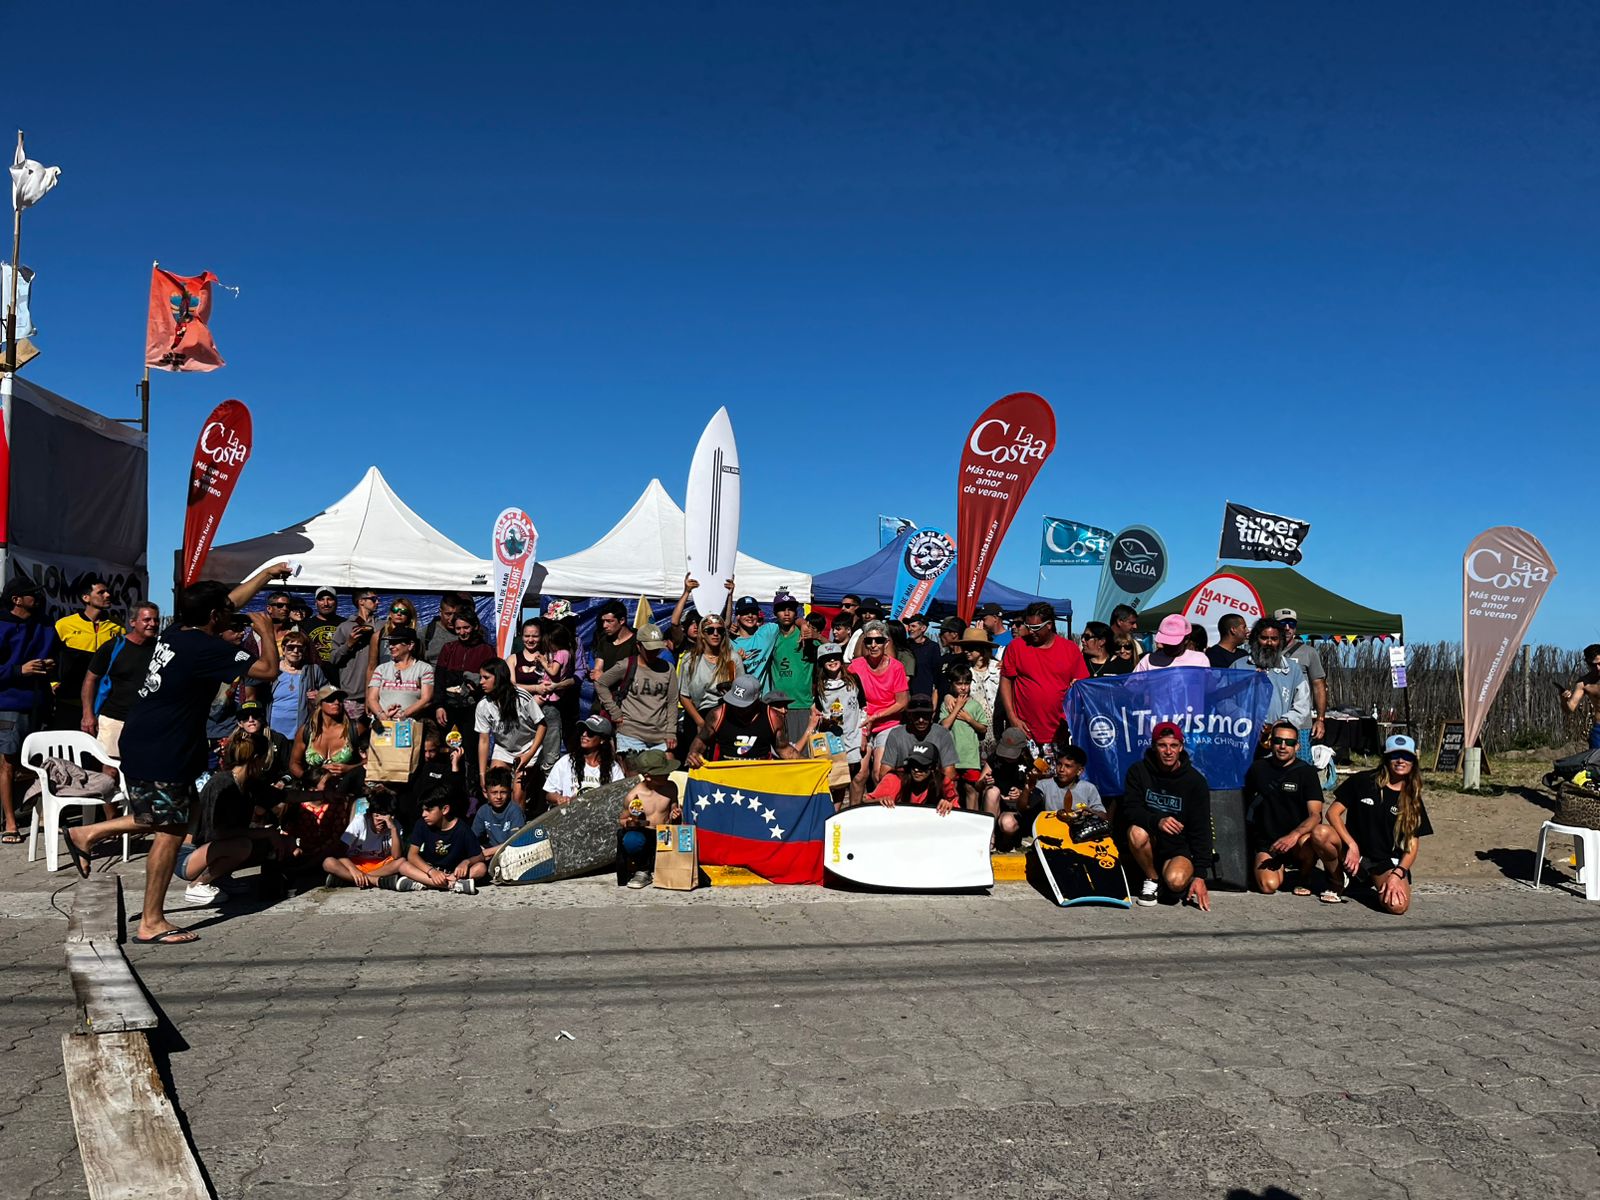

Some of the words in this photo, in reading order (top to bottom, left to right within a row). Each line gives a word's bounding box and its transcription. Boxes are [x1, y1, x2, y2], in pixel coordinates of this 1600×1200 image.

[201, 422, 247, 467] Costa
[227, 429, 239, 448] La
[970, 418, 1047, 465] Costa
[1015, 425, 1034, 446] La
[219, 471, 229, 481] un
[965, 464, 984, 476] Más
[986, 468, 1005, 479] que
[1005, 472, 1019, 481] un
[975, 477, 1002, 488] amor
[963, 484, 976, 494] de
[978, 488, 1009, 500] verano
[1235, 514, 1300, 537] super
[1046, 521, 1110, 557] Cost
[1238, 526, 1298, 552] tubos
[186, 514, 215, 583] www.lacosta.tur.ar
[1115, 560, 1156, 577] D'AGUA
[1466, 548, 1549, 589] Costa
[1512, 555, 1532, 572] La
[502, 572, 510, 587] MAR
[508, 565, 522, 590] SURF
[500, 588, 507, 597] DE
[1469, 590, 1489, 600] Más
[1491, 593, 1510, 603] que
[1511, 596, 1526, 604] un
[497, 598, 505, 614] AULA
[501, 591, 517, 627] PADDLE
[1201, 587, 1259, 617] MATEOS
[1481, 601, 1508, 611] amor
[1469, 608, 1482, 616] de
[1484, 610, 1518, 620] verano
